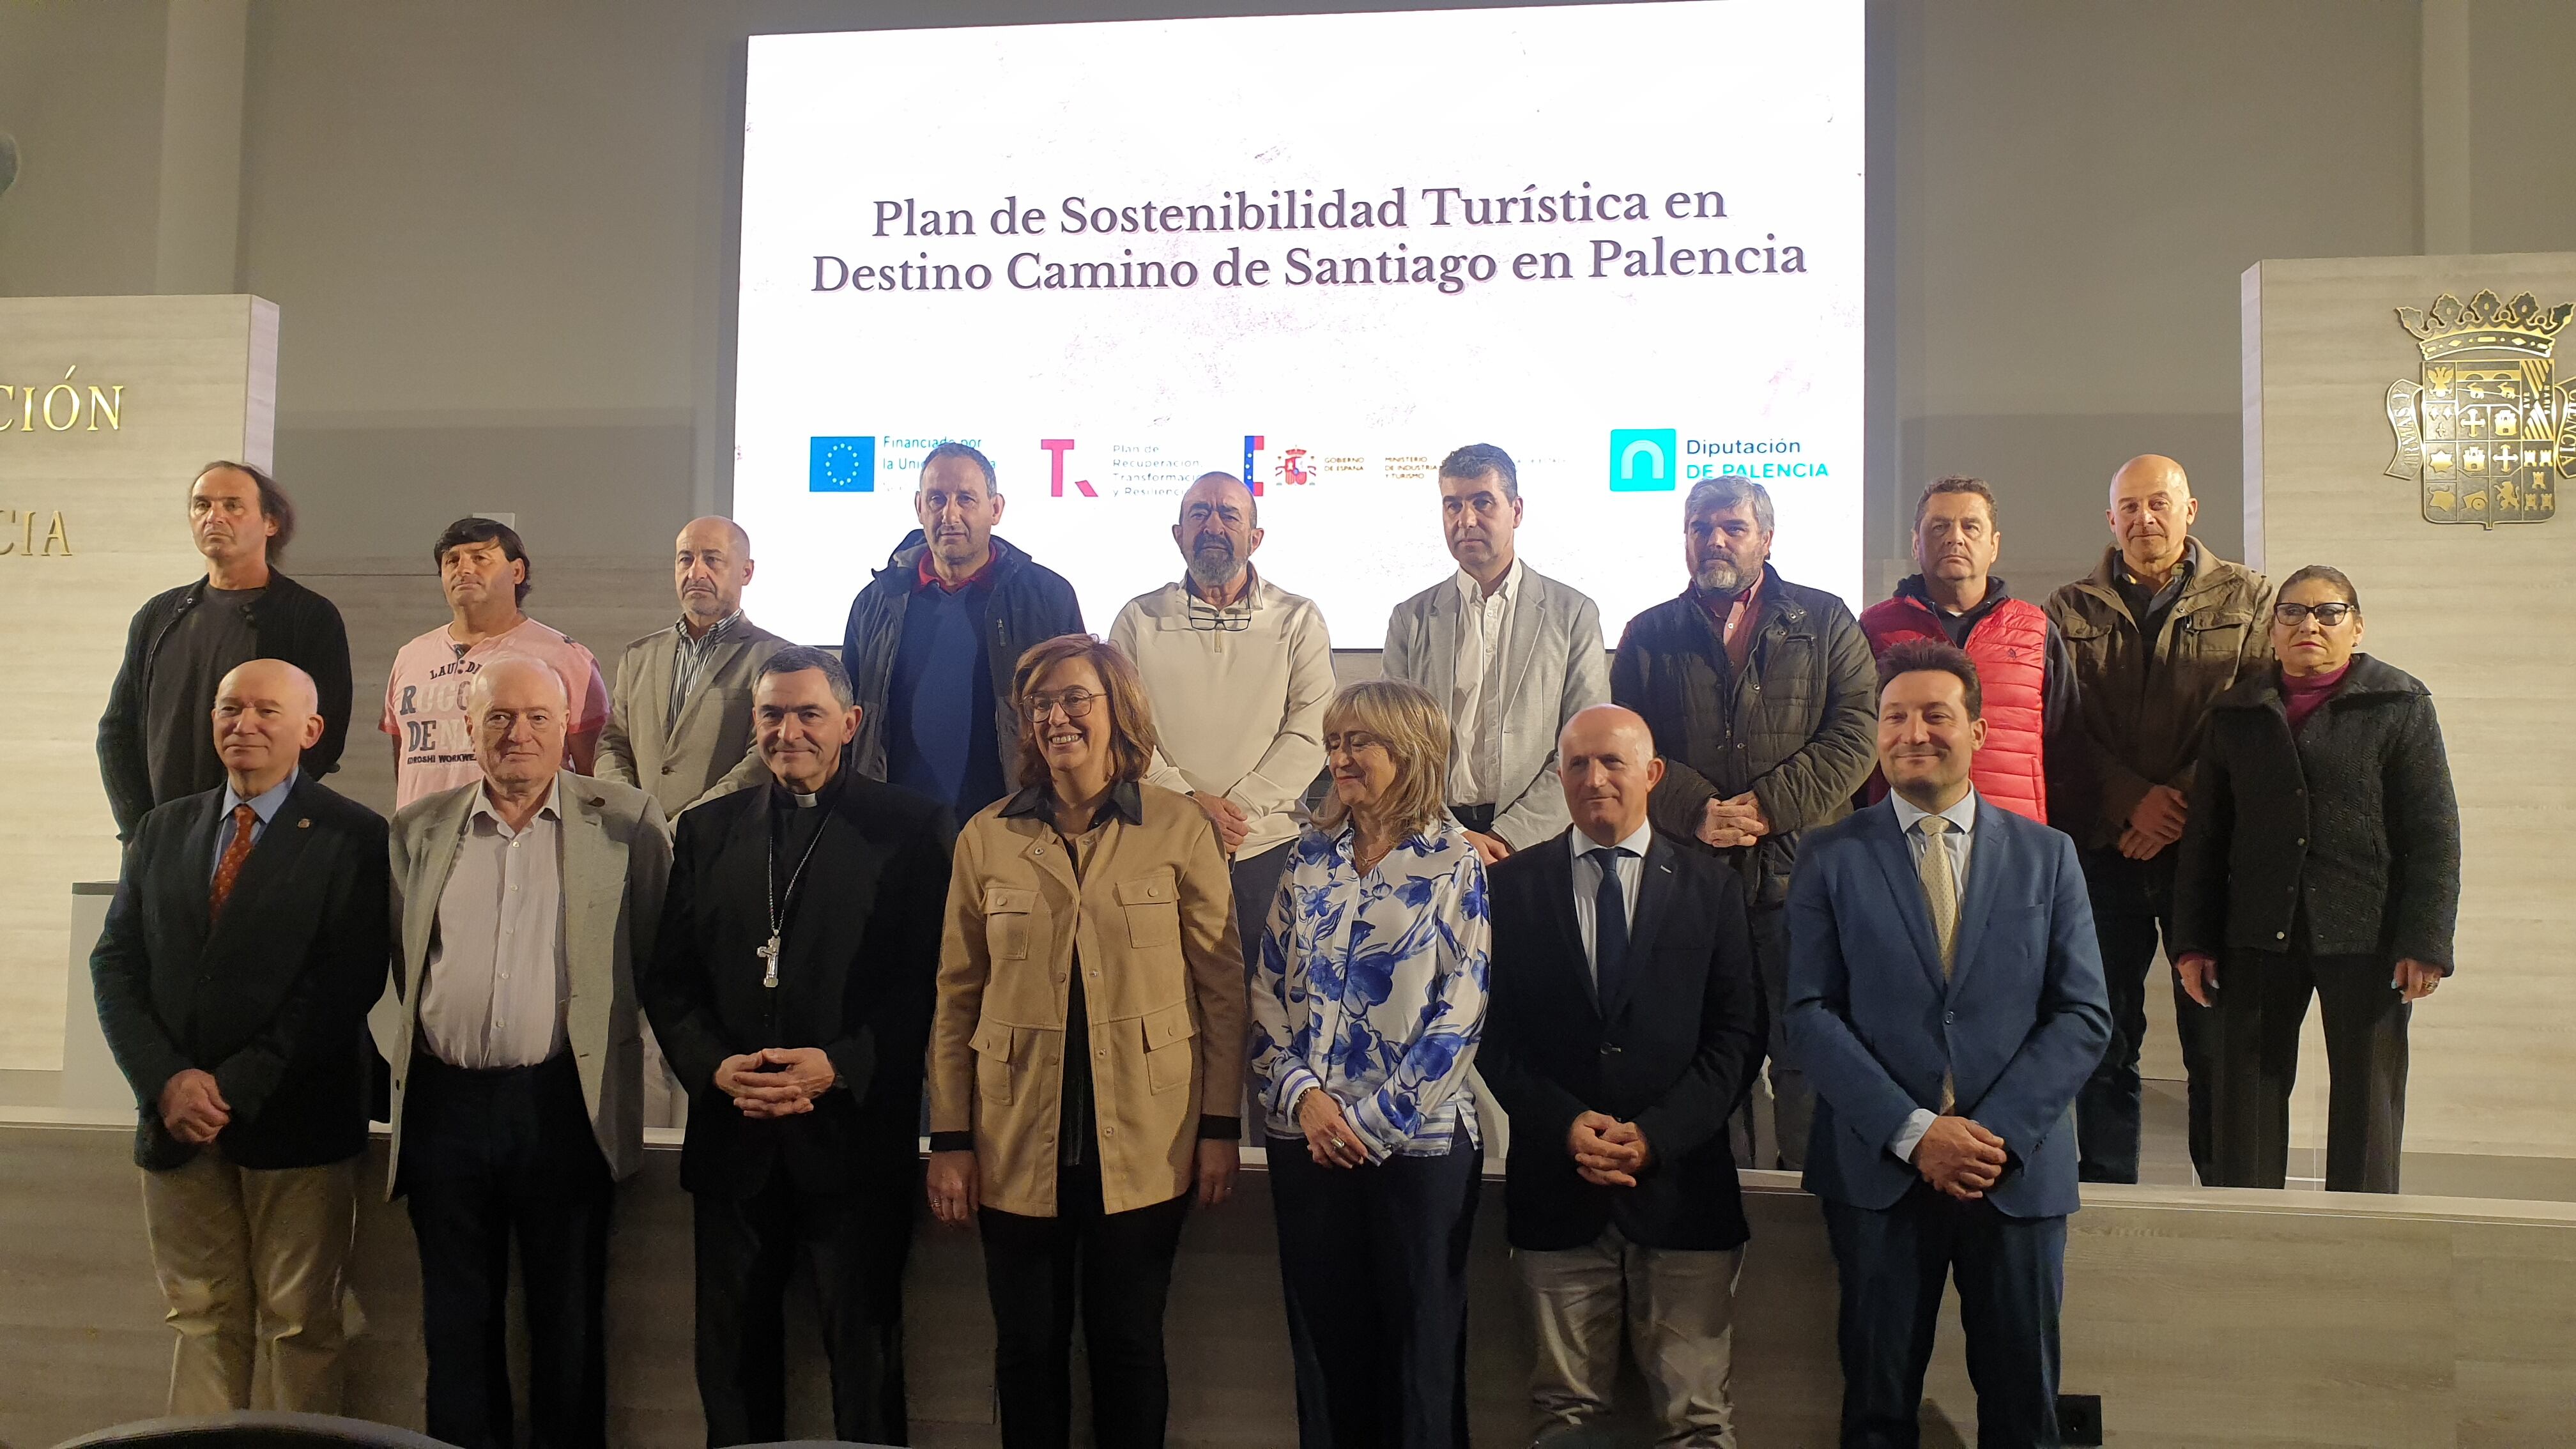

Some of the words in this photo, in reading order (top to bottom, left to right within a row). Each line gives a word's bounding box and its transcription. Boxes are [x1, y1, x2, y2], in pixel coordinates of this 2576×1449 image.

[872, 198, 976, 236] Plan
[990, 195, 1045, 235] de
[1061, 187, 1407, 234] Sostenibilidad
[1422, 181, 1649, 226] Turística
[1665, 191, 1728, 218] en
[811, 252, 992, 291] Destino
[1007, 249, 1198, 289] Camino
[1213, 247, 1270, 287] de
[1285, 243, 1496, 294] Santiago
[1512, 252, 1574, 280] en
[1588, 233, 1807, 277] Palencia
[1144, 445, 1160, 454] de
[1687, 438, 1800, 457] Diputación
[883, 458, 893, 470] la
[1687, 464, 1712, 479] DE
[1722, 463, 1829, 479] PALENCIA
[1124, 487, 1184, 496] Resilienci
[438, 753, 477, 763] WORKWE
